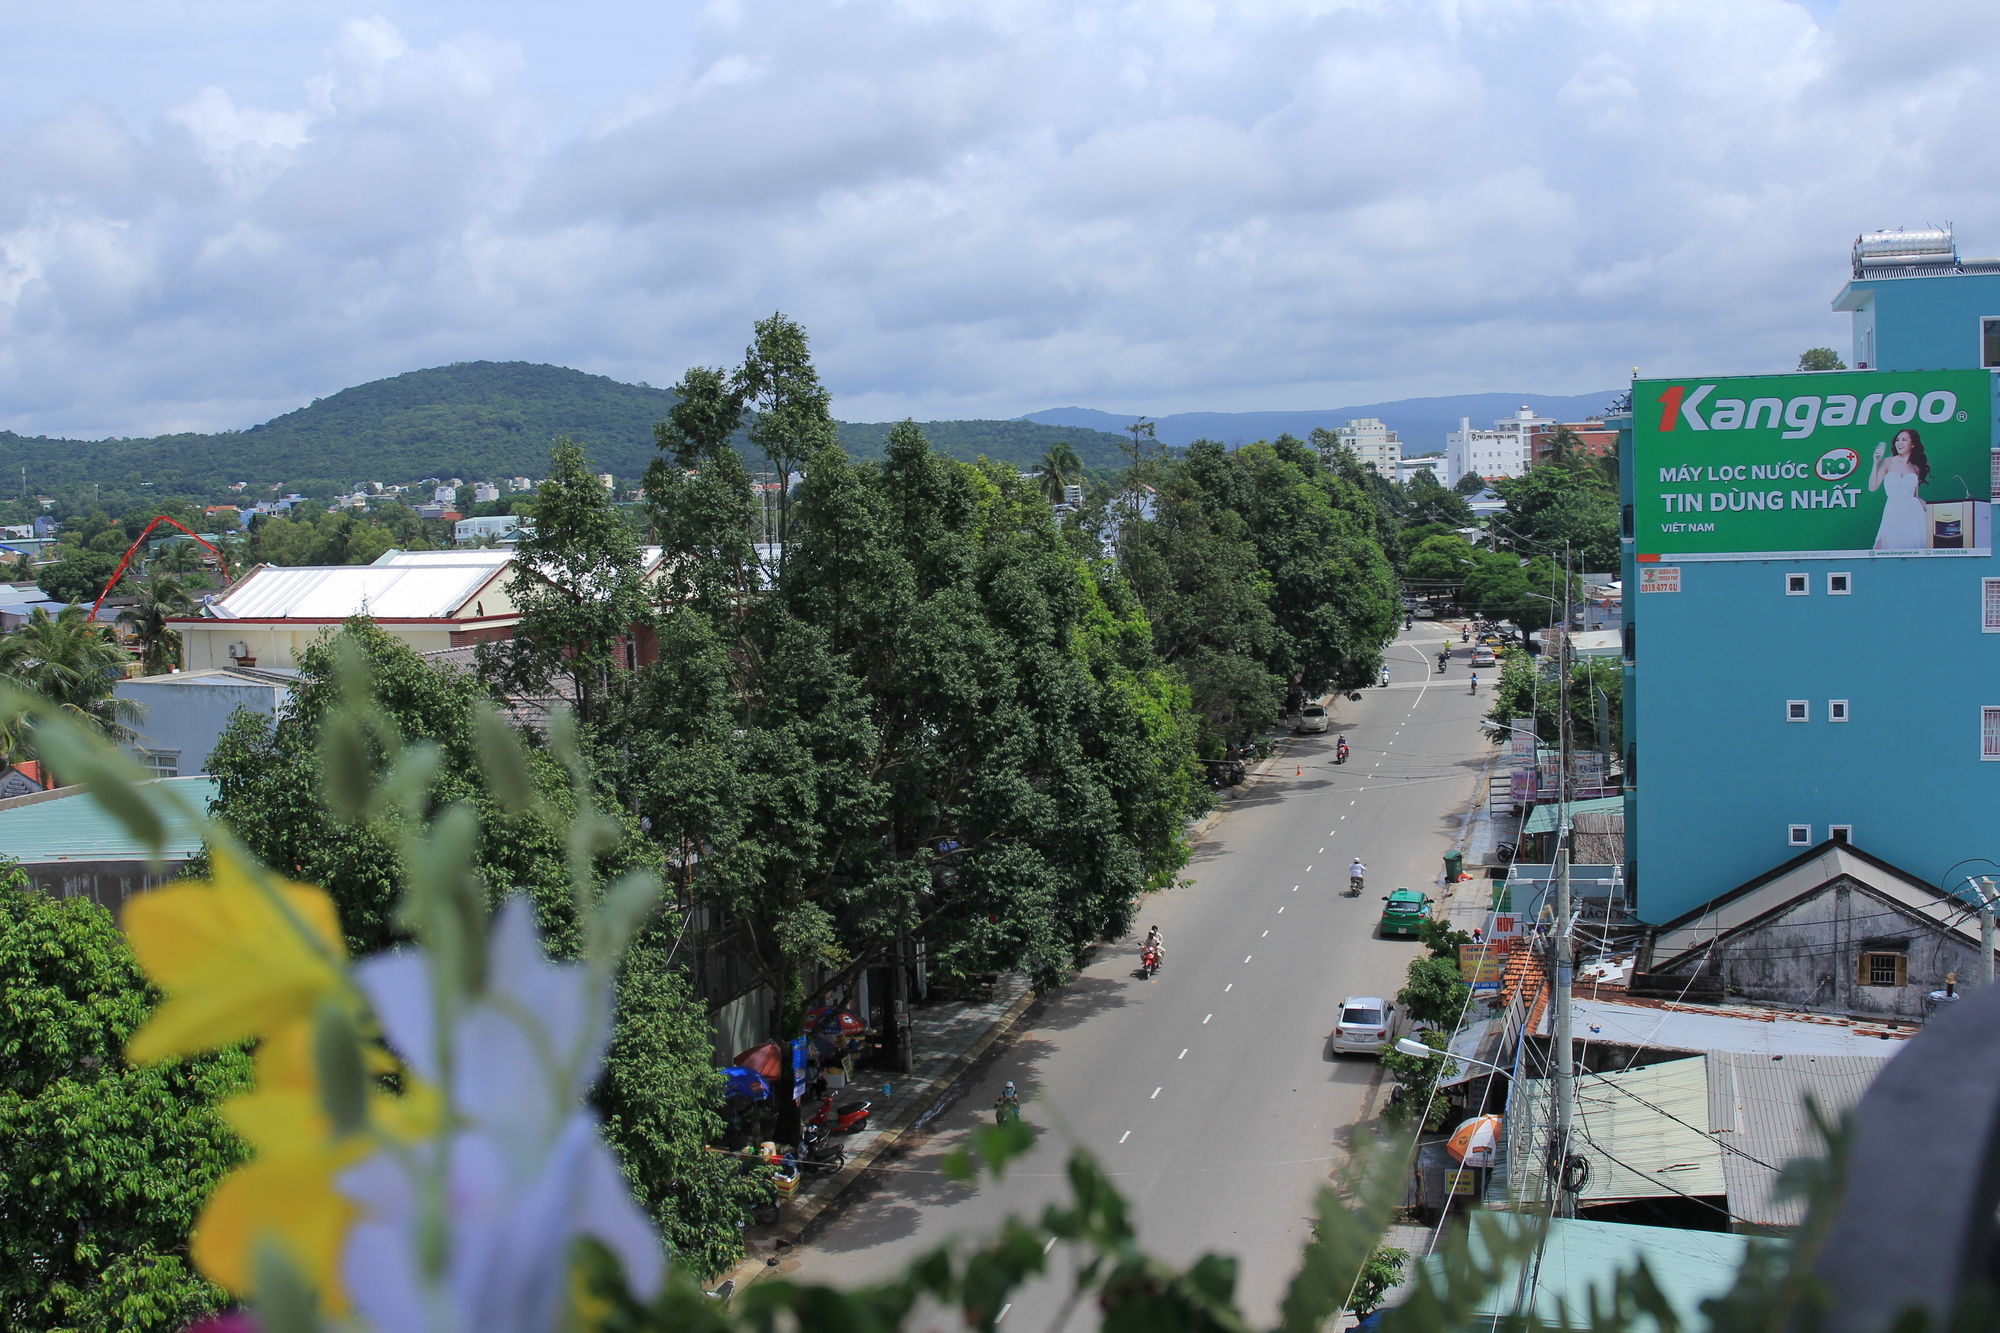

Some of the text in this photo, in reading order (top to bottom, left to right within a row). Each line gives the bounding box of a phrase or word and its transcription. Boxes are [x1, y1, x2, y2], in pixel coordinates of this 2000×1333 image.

[1659, 463, 1703, 482] MÁY
[1708, 465, 1746, 484] LỌC
[1751, 460, 1809, 480] NƯỚC
[1660, 483, 1862, 513] TIN DÙNG NHẤT
[1661, 521, 1715, 534] VIỆT NAM
[1496, 917, 1514, 932] HUY
